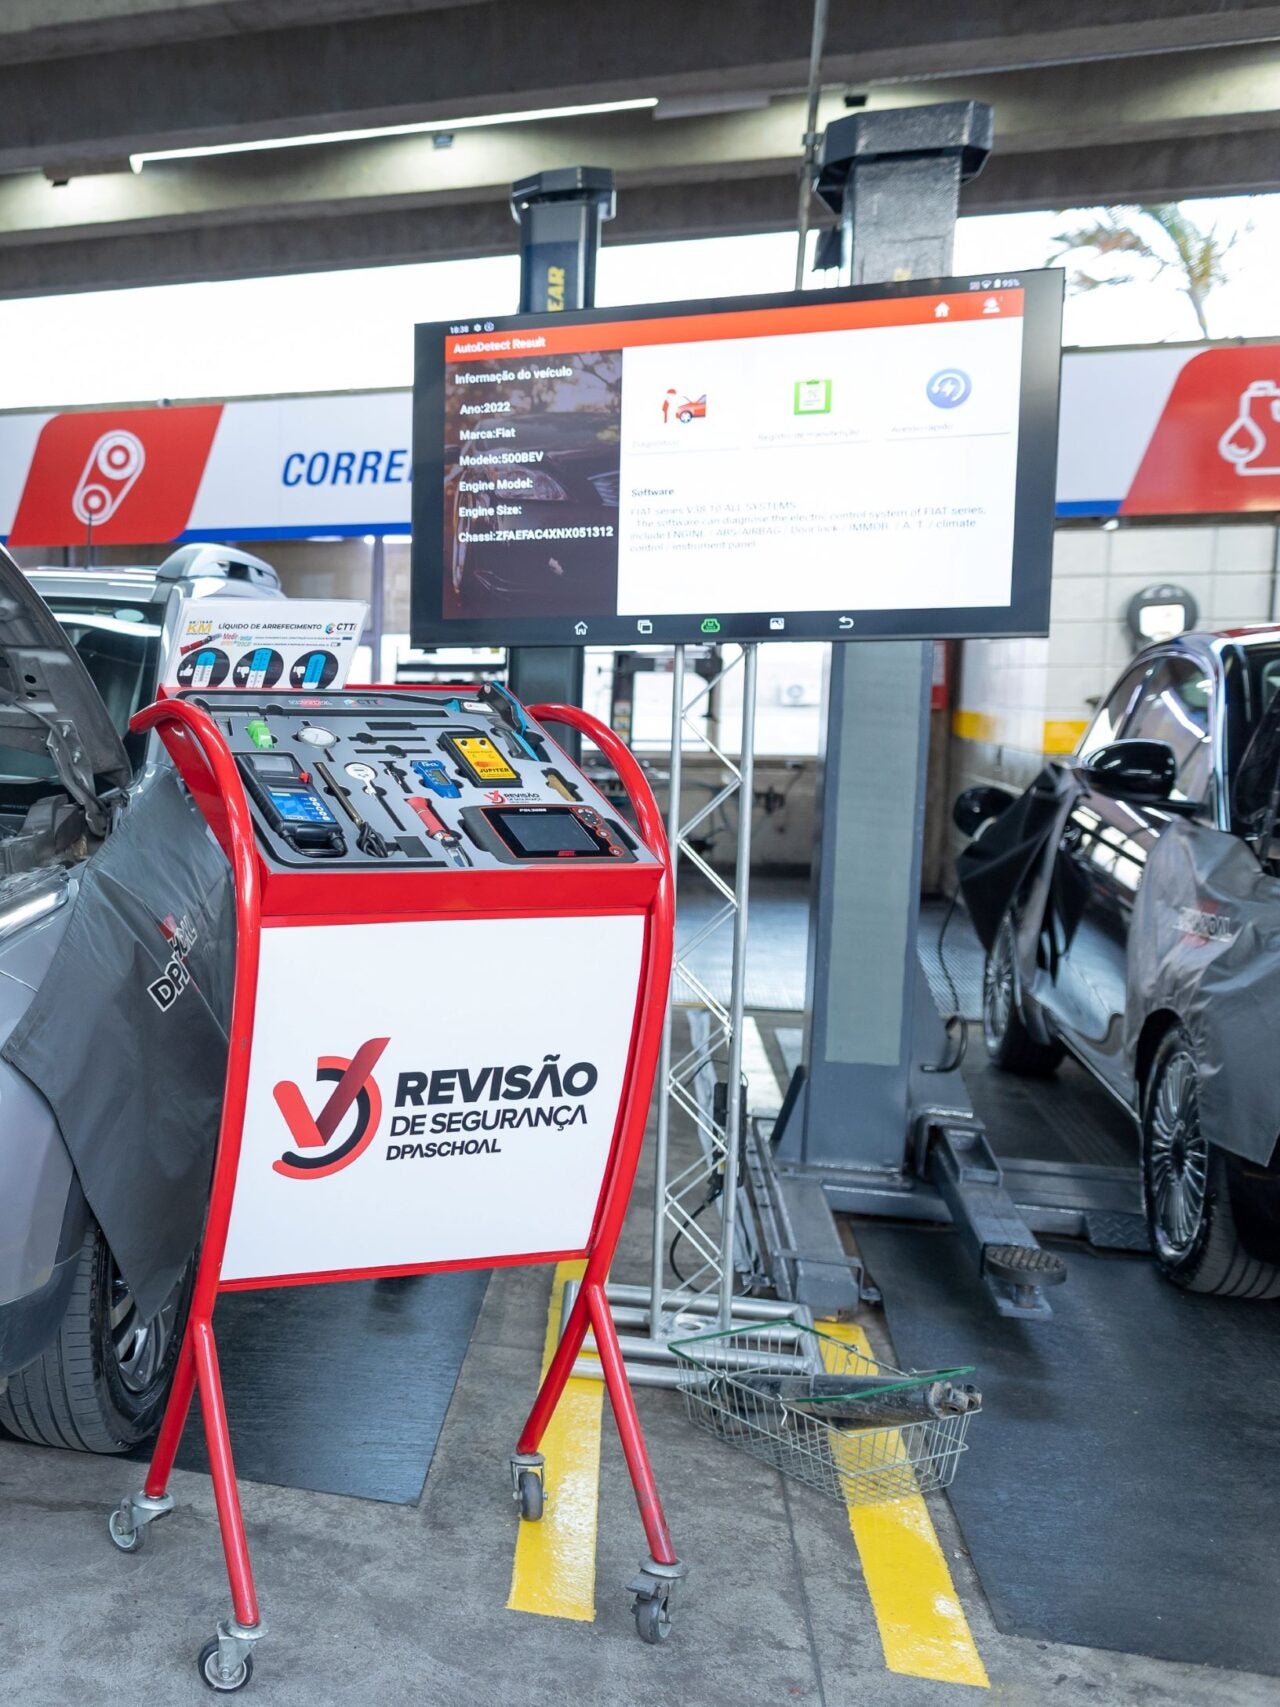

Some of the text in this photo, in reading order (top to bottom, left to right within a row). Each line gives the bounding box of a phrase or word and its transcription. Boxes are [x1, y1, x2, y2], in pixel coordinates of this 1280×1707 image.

[454, 336, 546, 354] AutoDetect Result
[455, 366, 573, 385] Informação do veículo
[460, 401, 511, 415] Ano:2022
[460, 428, 516, 440] Marca:Fiat
[459, 451, 544, 466] Modelo:500BEV
[282, 449, 414, 486] CORRE
[459, 478, 533, 493] Engine Model:
[631, 488, 674, 497] Software
[459, 505, 522, 518] Engine Size:
[869, 509, 907, 520] system
[924, 507, 946, 516] FIAT
[936, 519, 976, 528] climate
[187, 623, 212, 633] KM
[218, 622, 249, 630] LÍQUIDO
[394, 1054, 598, 1108] REVISÃO
[390, 1105, 588, 1137] DE SEGURANÇA
[386, 1138, 502, 1161] DPASCHOAL
